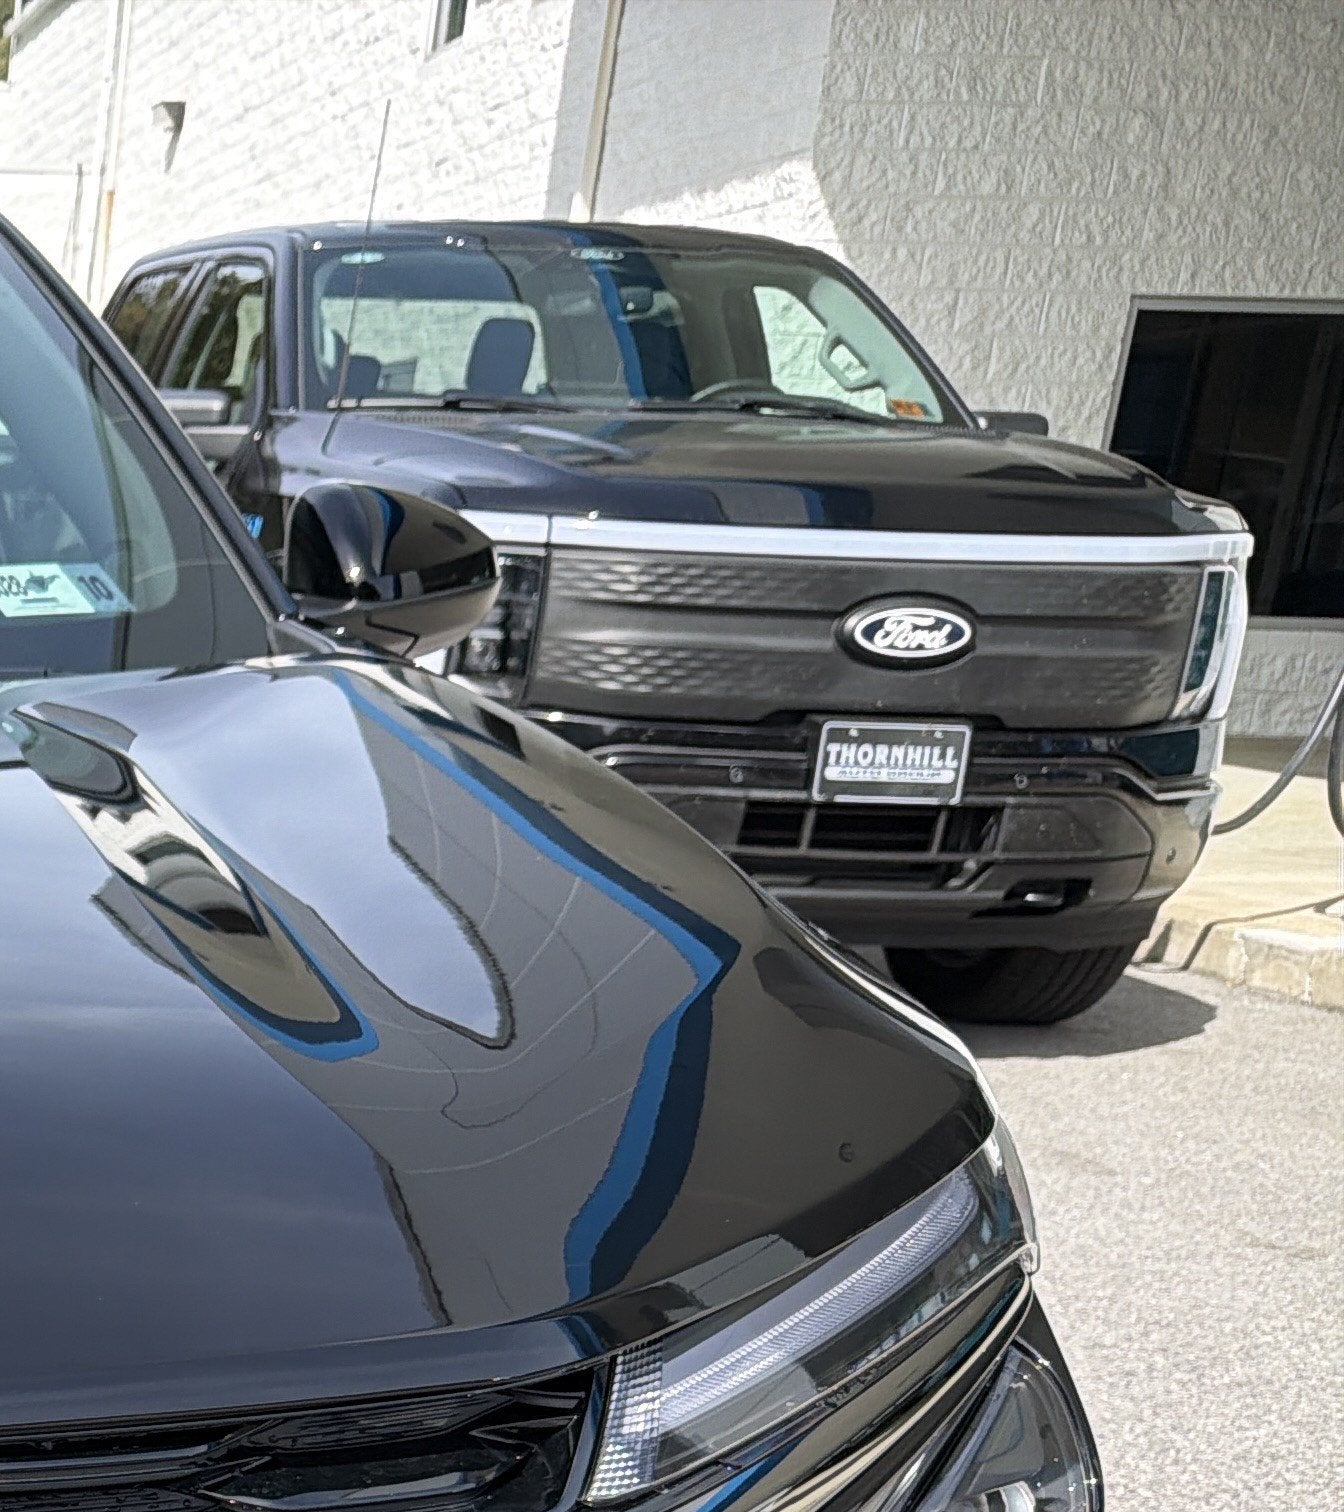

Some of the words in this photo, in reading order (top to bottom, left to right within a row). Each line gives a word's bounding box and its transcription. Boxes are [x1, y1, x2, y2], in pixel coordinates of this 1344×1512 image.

[77, 575, 113, 601] 10
[873, 614, 952, 648] Ford
[826, 743, 958, 768] THORNHILL
